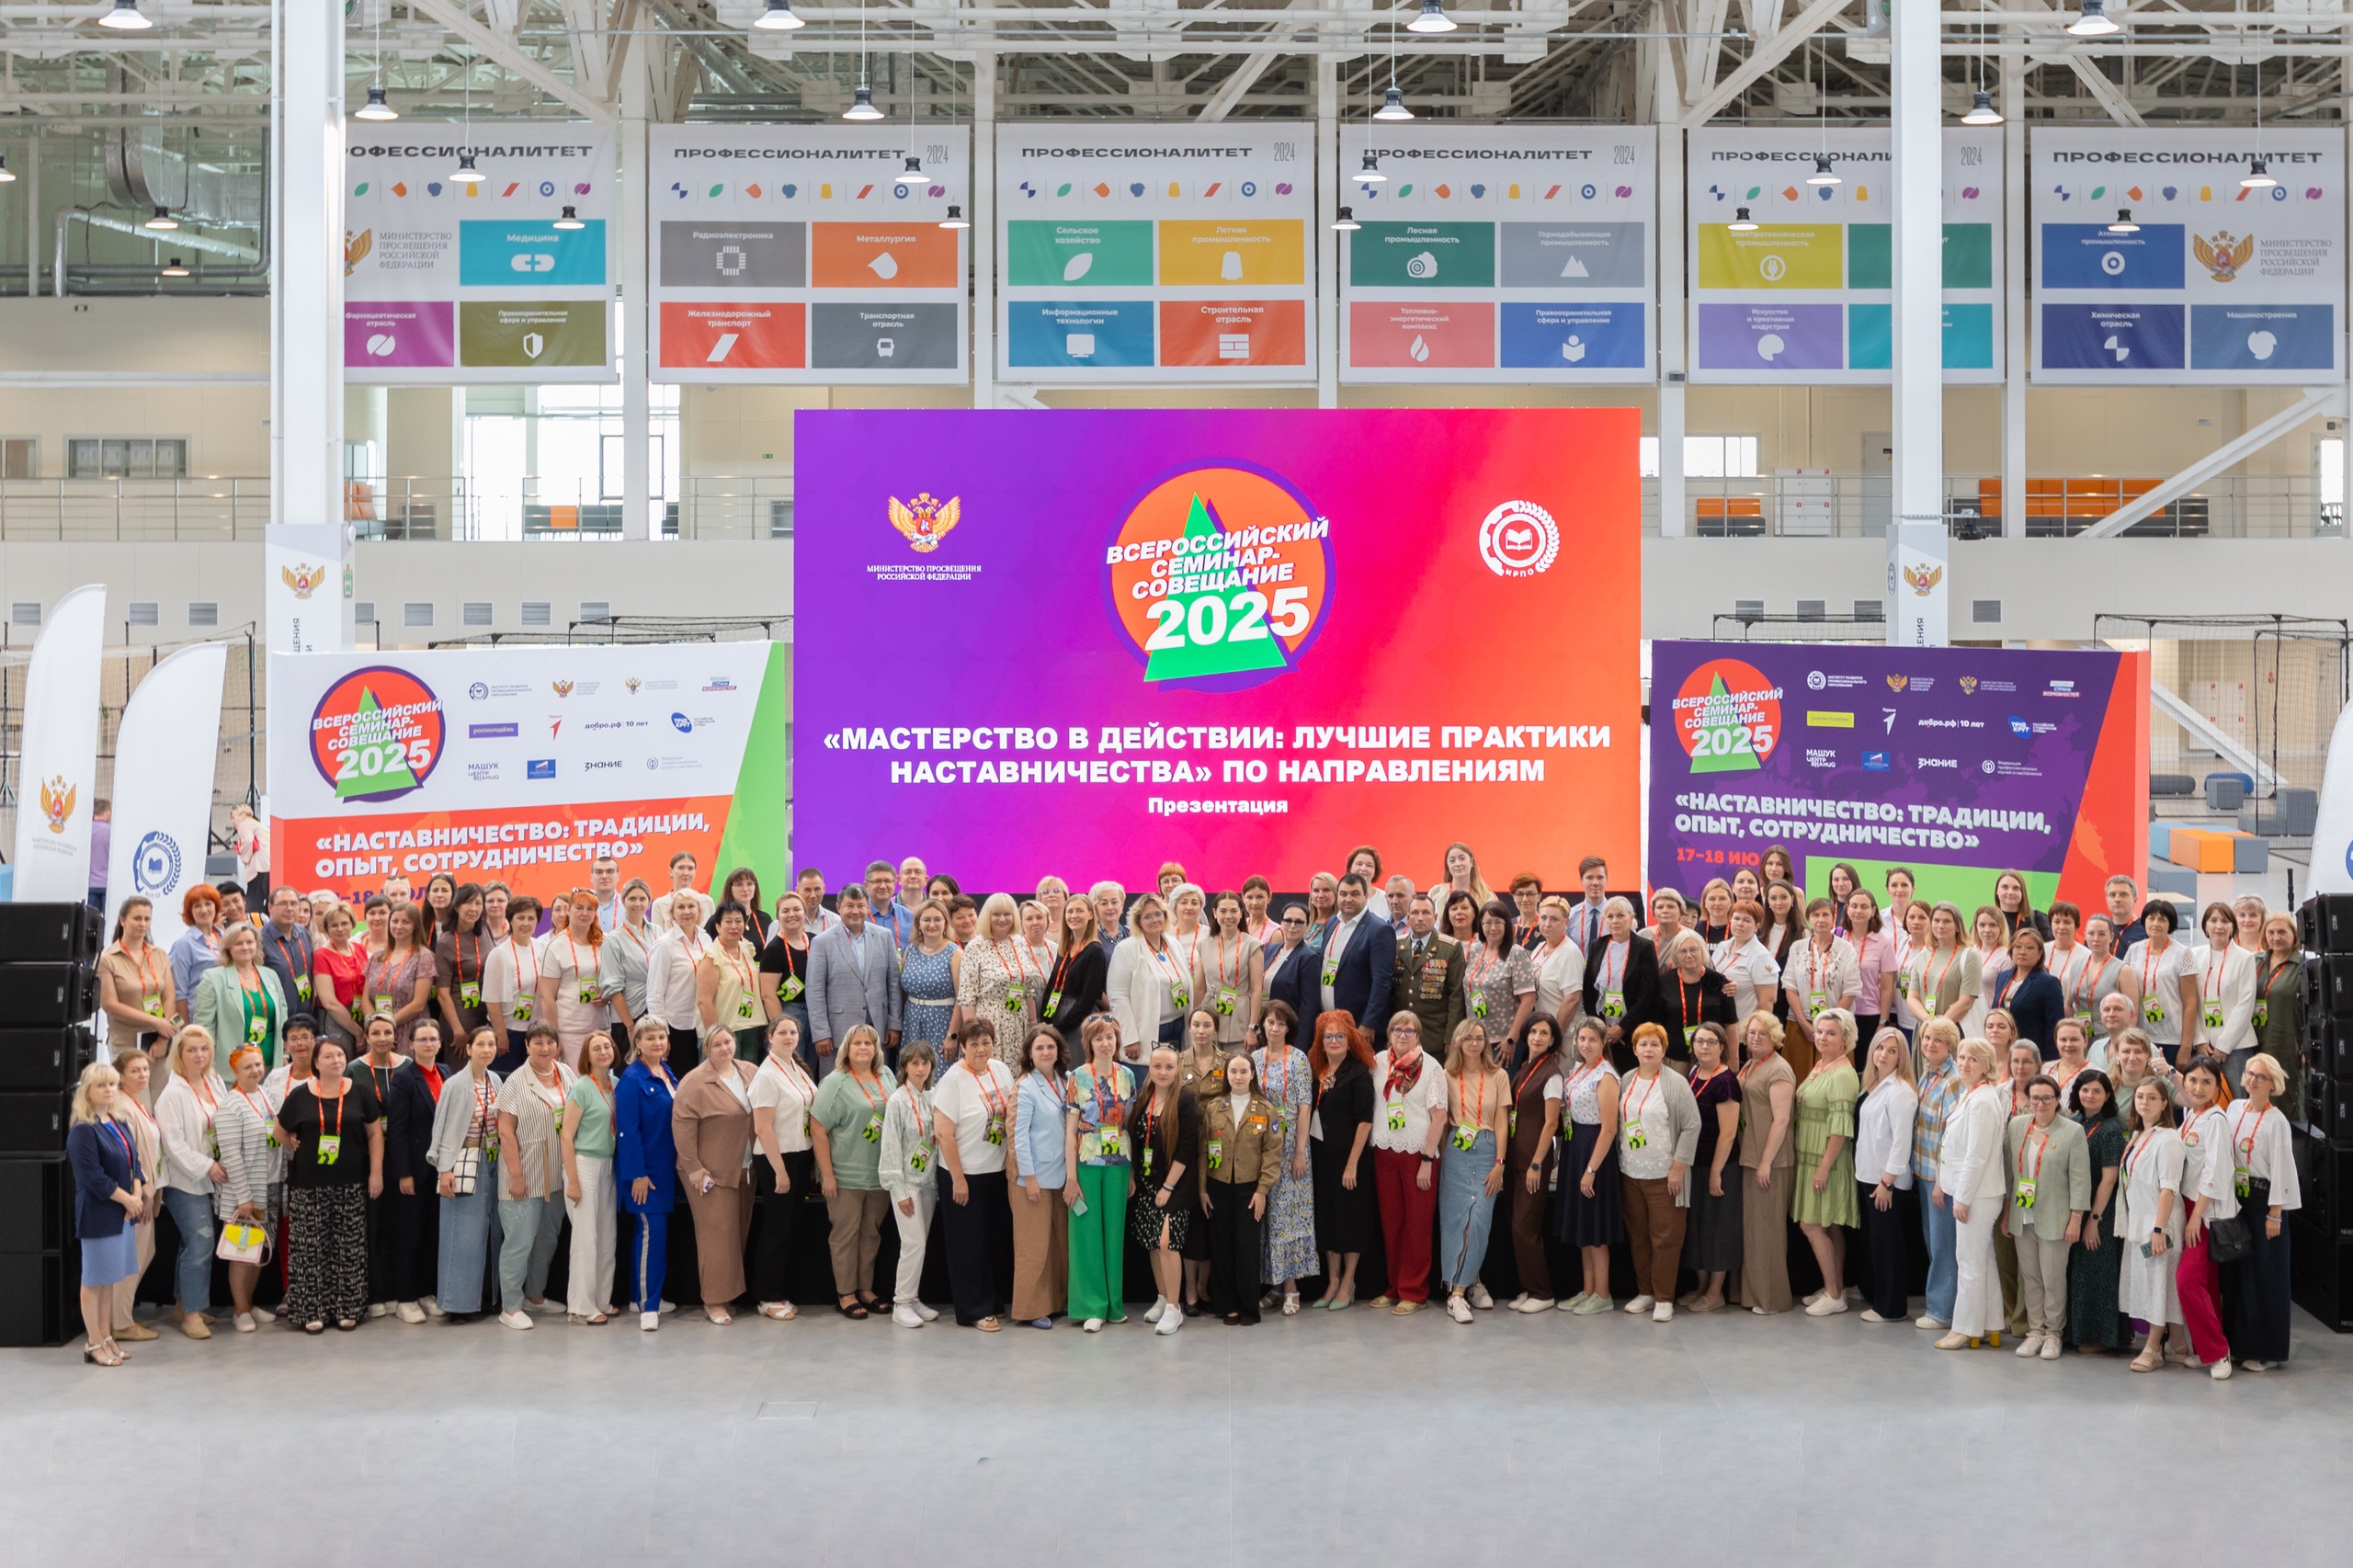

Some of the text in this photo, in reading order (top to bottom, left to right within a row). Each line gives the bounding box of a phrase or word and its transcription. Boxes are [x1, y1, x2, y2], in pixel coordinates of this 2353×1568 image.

[345, 146, 592, 157] ОФЕССИОНАЛИТЕТ
[675, 149, 905, 158] ПРОФЕССИОНАЛИТЕТ
[926, 145, 949, 164] 2024
[1022, 148, 1252, 157] ПРОФЕССИОНАЛИТЕТ
[1274, 142, 1295, 162] 2024
[1364, 149, 1593, 160] ПРОФЕССИОНАЛИТЕТ
[1614, 145, 1634, 165] 2024
[1961, 147, 1982, 165] 2024
[1711, 152, 1892, 162] ПРОФЕССИОНАЛИ
[2053, 152, 2323, 163] ПРОФЕССИОНАЛИТЕТ
[1216, 226, 1247, 234] Легкая
[1407, 227, 1438, 235] Лесная
[380, 233, 451, 241] МИНИСТЕРСТВО
[507, 233, 559, 244] Медицина
[693, 232, 773, 240] Радиоэлектроника
[857, 235, 915, 244] Металлургия
[1192, 235, 1270, 244] промышленность
[1385, 235, 1460, 244] промышленность
[1539, 231, 1611, 239] Горнодобывающая
[1055, 236, 1100, 244] хозяйство
[1736, 239, 1809, 247] промышленность
[2260, 239, 2331, 247] МИНИСТЕРСТВО
[380, 242, 448, 251] ПРОСВЕЩЕНИЯ
[380, 251, 438, 259] РОССИЙСКОЙ
[2260, 249, 2327, 258] ПРОСВЕЩЕНИЯ
[380, 260, 434, 269] ФЕДЕРАЦИИ
[2260, 258, 2320, 267] РОССИЙСКОЙ
[2260, 267, 2314, 276] ФЕДЕРАЦИИ
[688, 310, 770, 319] Железнодорожный
[1042, 309, 1118, 317] Информационные
[1201, 306, 1264, 315] Строительная
[1536, 309, 1611, 317] Правоохранительная
[1752, 308, 1788, 316] Искусство
[346, 312, 416, 320] Фармацевтическая
[860, 312, 914, 321] Транспортная
[1216, 315, 1251, 324] отрасль
[1391, 315, 1449, 324] энергетический
[2091, 312, 2140, 320] Химическая
[708, 320, 751, 329] транспорт
[873, 321, 904, 329] отрасль
[1107, 517, 1329, 564] ВСЕРОССИЙСКИЙ
[1151, 547, 1280, 579] СЕМИНАР-
[1506, 568, 1534, 577] ИРПО
[1132, 562, 1294, 599] СОВЕЩАНИЕ
[1145, 586, 1310, 651] 2025
[1673, 687, 1783, 710] ВСЕРОССИЙСКИЙ
[313, 699, 443, 730] ВСЕРОССИЙСКИЙ
[1694, 703, 1758, 717] СЕМИНАР-
[1685, 712, 1765, 729] СОВЕЩАНИЕ
[1918, 719, 1956, 728] добро.рф
[339, 717, 414, 736] СЕМИНАР-
[328, 726, 422, 750] СОВЕЩАНИЕ
[824, 722, 1610, 754] «МАСТЕРСТВО В ДЕЙСТВИИ: ЛУЧШИЕ ПРАКТИКИ
[1690, 725, 1772, 756] 2025
[1806, 749, 1836, 757] МАШУК
[335, 739, 431, 780] 2025
[892, 760, 1545, 783] НАСТАВНИЧЕСТВА» ПО НАПРАВЛЕНИЯМ
[1149, 798, 1288, 816] Презентация
[1676, 792, 2052, 835] «НАСТАВНИЧЕСТВО: ТРАДИЦИИ,
[316, 813, 710, 852] «НАСТАВНИЧЕСТВО: ТРАДИЦИИ,
[1675, 814, 1980, 849] ОПЫТ, СОТРУДНИЧЕСТВО»
[316, 842, 644, 877] ОПЫТ, СОТРУДНИЧЕСТВО»
[1729, 851, 1759, 866] ИЮ
